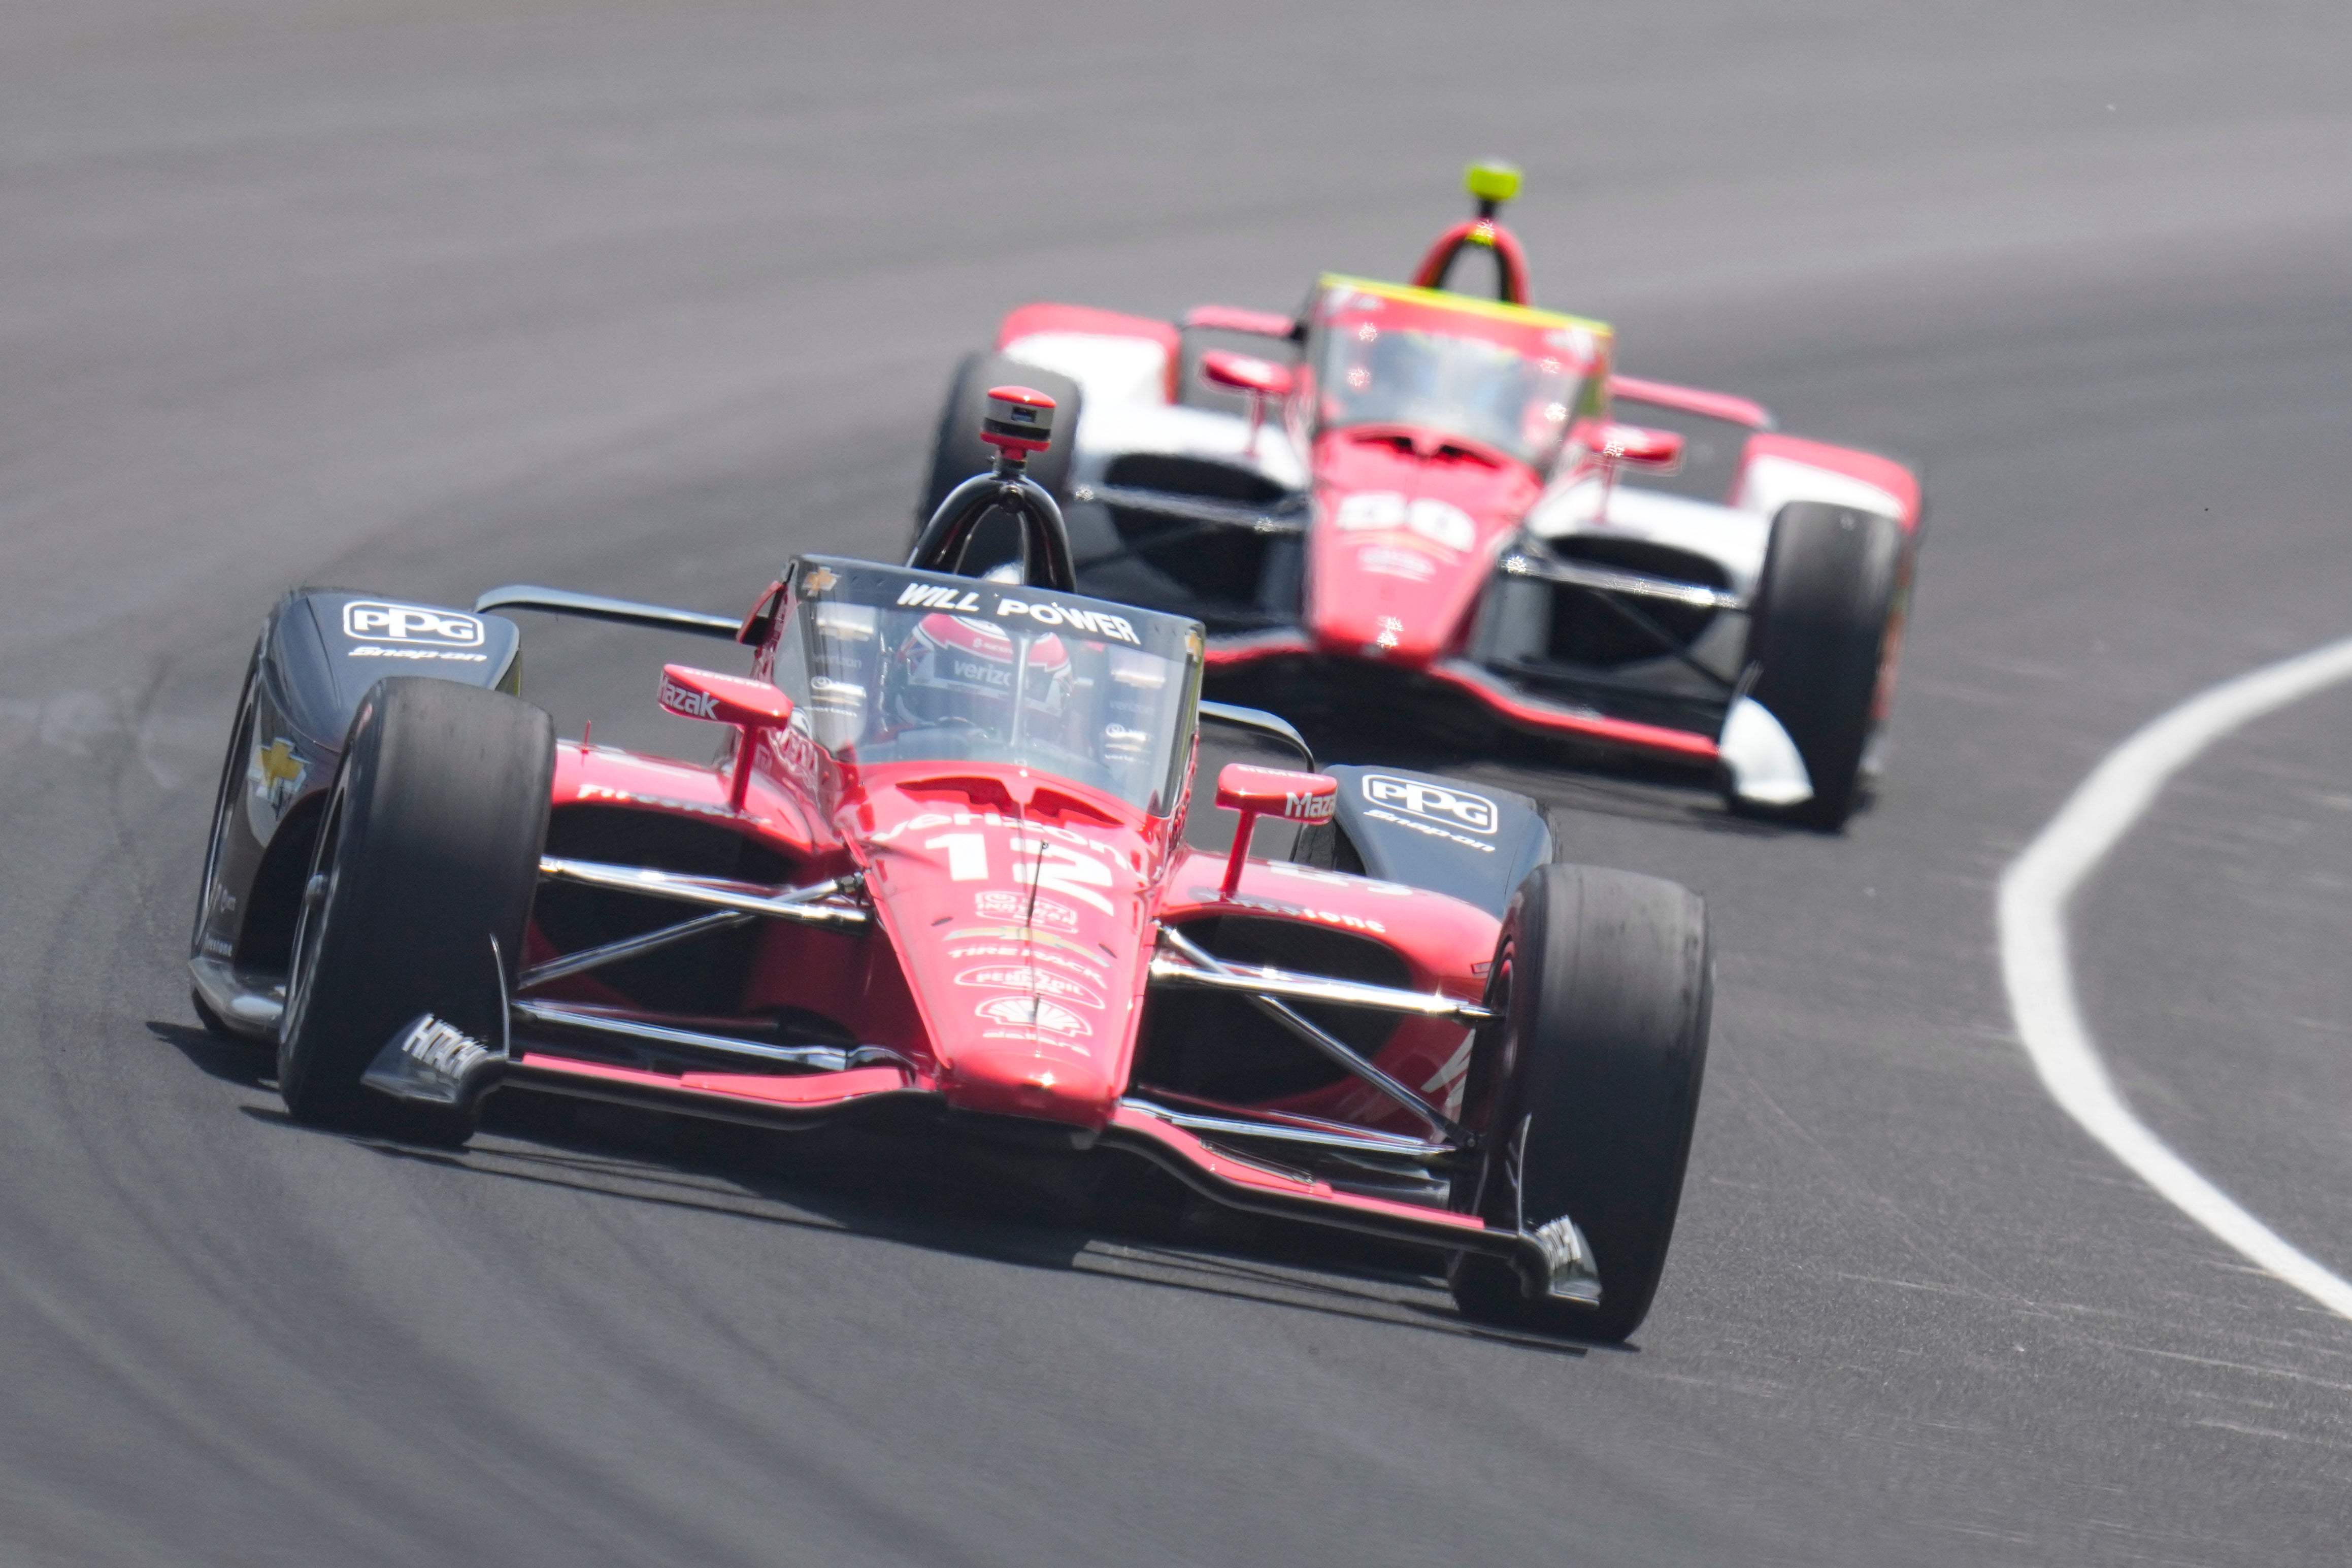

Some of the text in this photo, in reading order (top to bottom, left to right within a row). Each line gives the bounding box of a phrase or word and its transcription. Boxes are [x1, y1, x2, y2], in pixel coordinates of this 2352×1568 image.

[354, 609, 474, 640] PPG
[897, 582, 1141, 645] WILL POWER
[348, 647, 487, 662] Snap-on
[1372, 781, 1488, 826] PPG
[870, 812, 1128, 871] verizon
[1363, 809, 1496, 852] Snap-on
[924, 832, 1114, 917] 12
[947, 946, 1018, 958] TIRE
[1021, 947, 1108, 990] RACK
